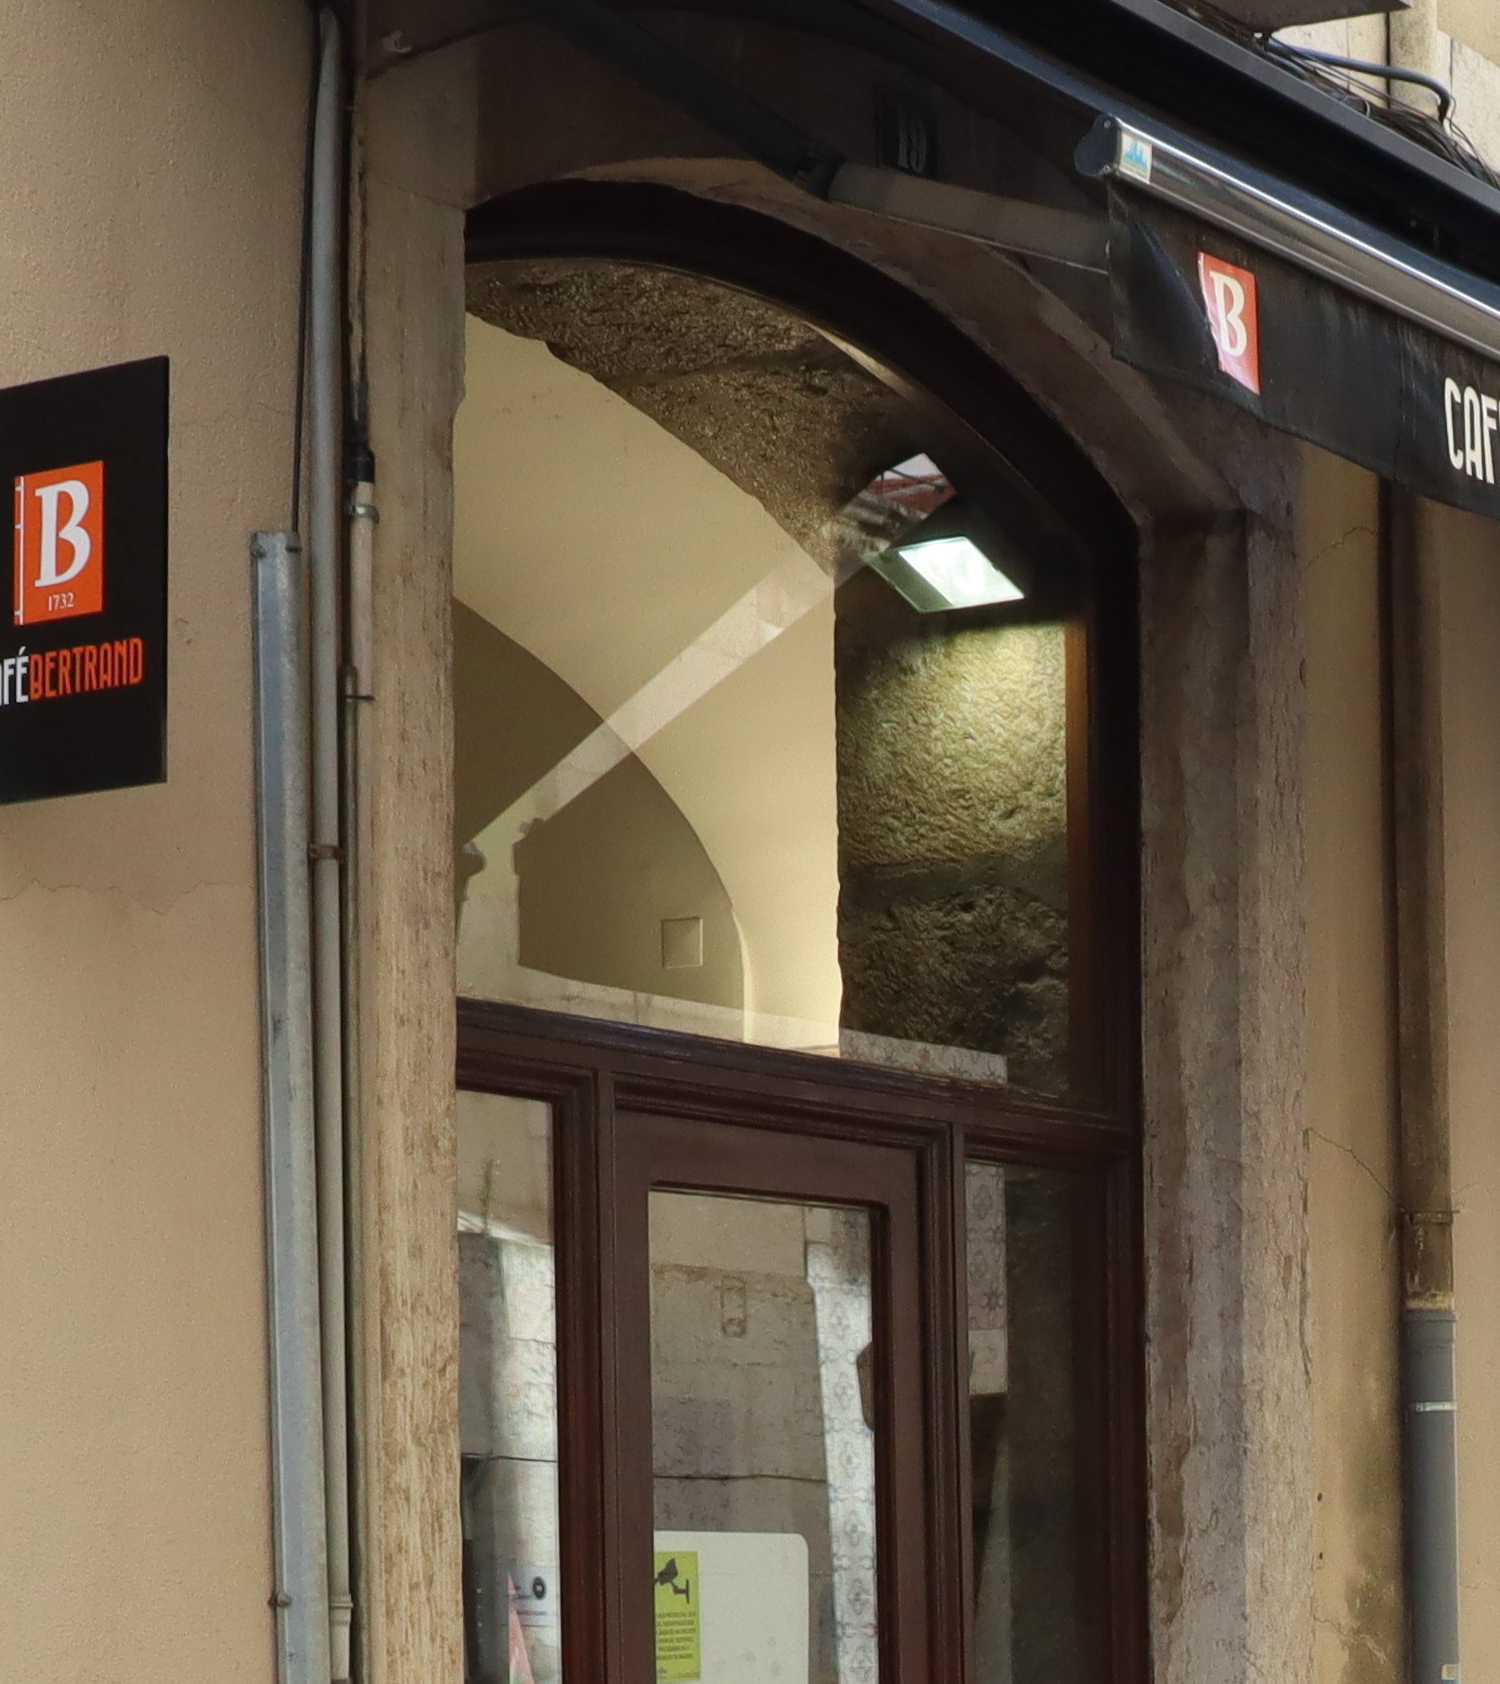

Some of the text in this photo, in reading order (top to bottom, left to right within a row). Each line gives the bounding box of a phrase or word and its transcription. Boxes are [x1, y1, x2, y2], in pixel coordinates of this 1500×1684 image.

[1209, 270, 1248, 357] B
[34, 479, 91, 587] B
[47, 592, 75, 612] 1732
